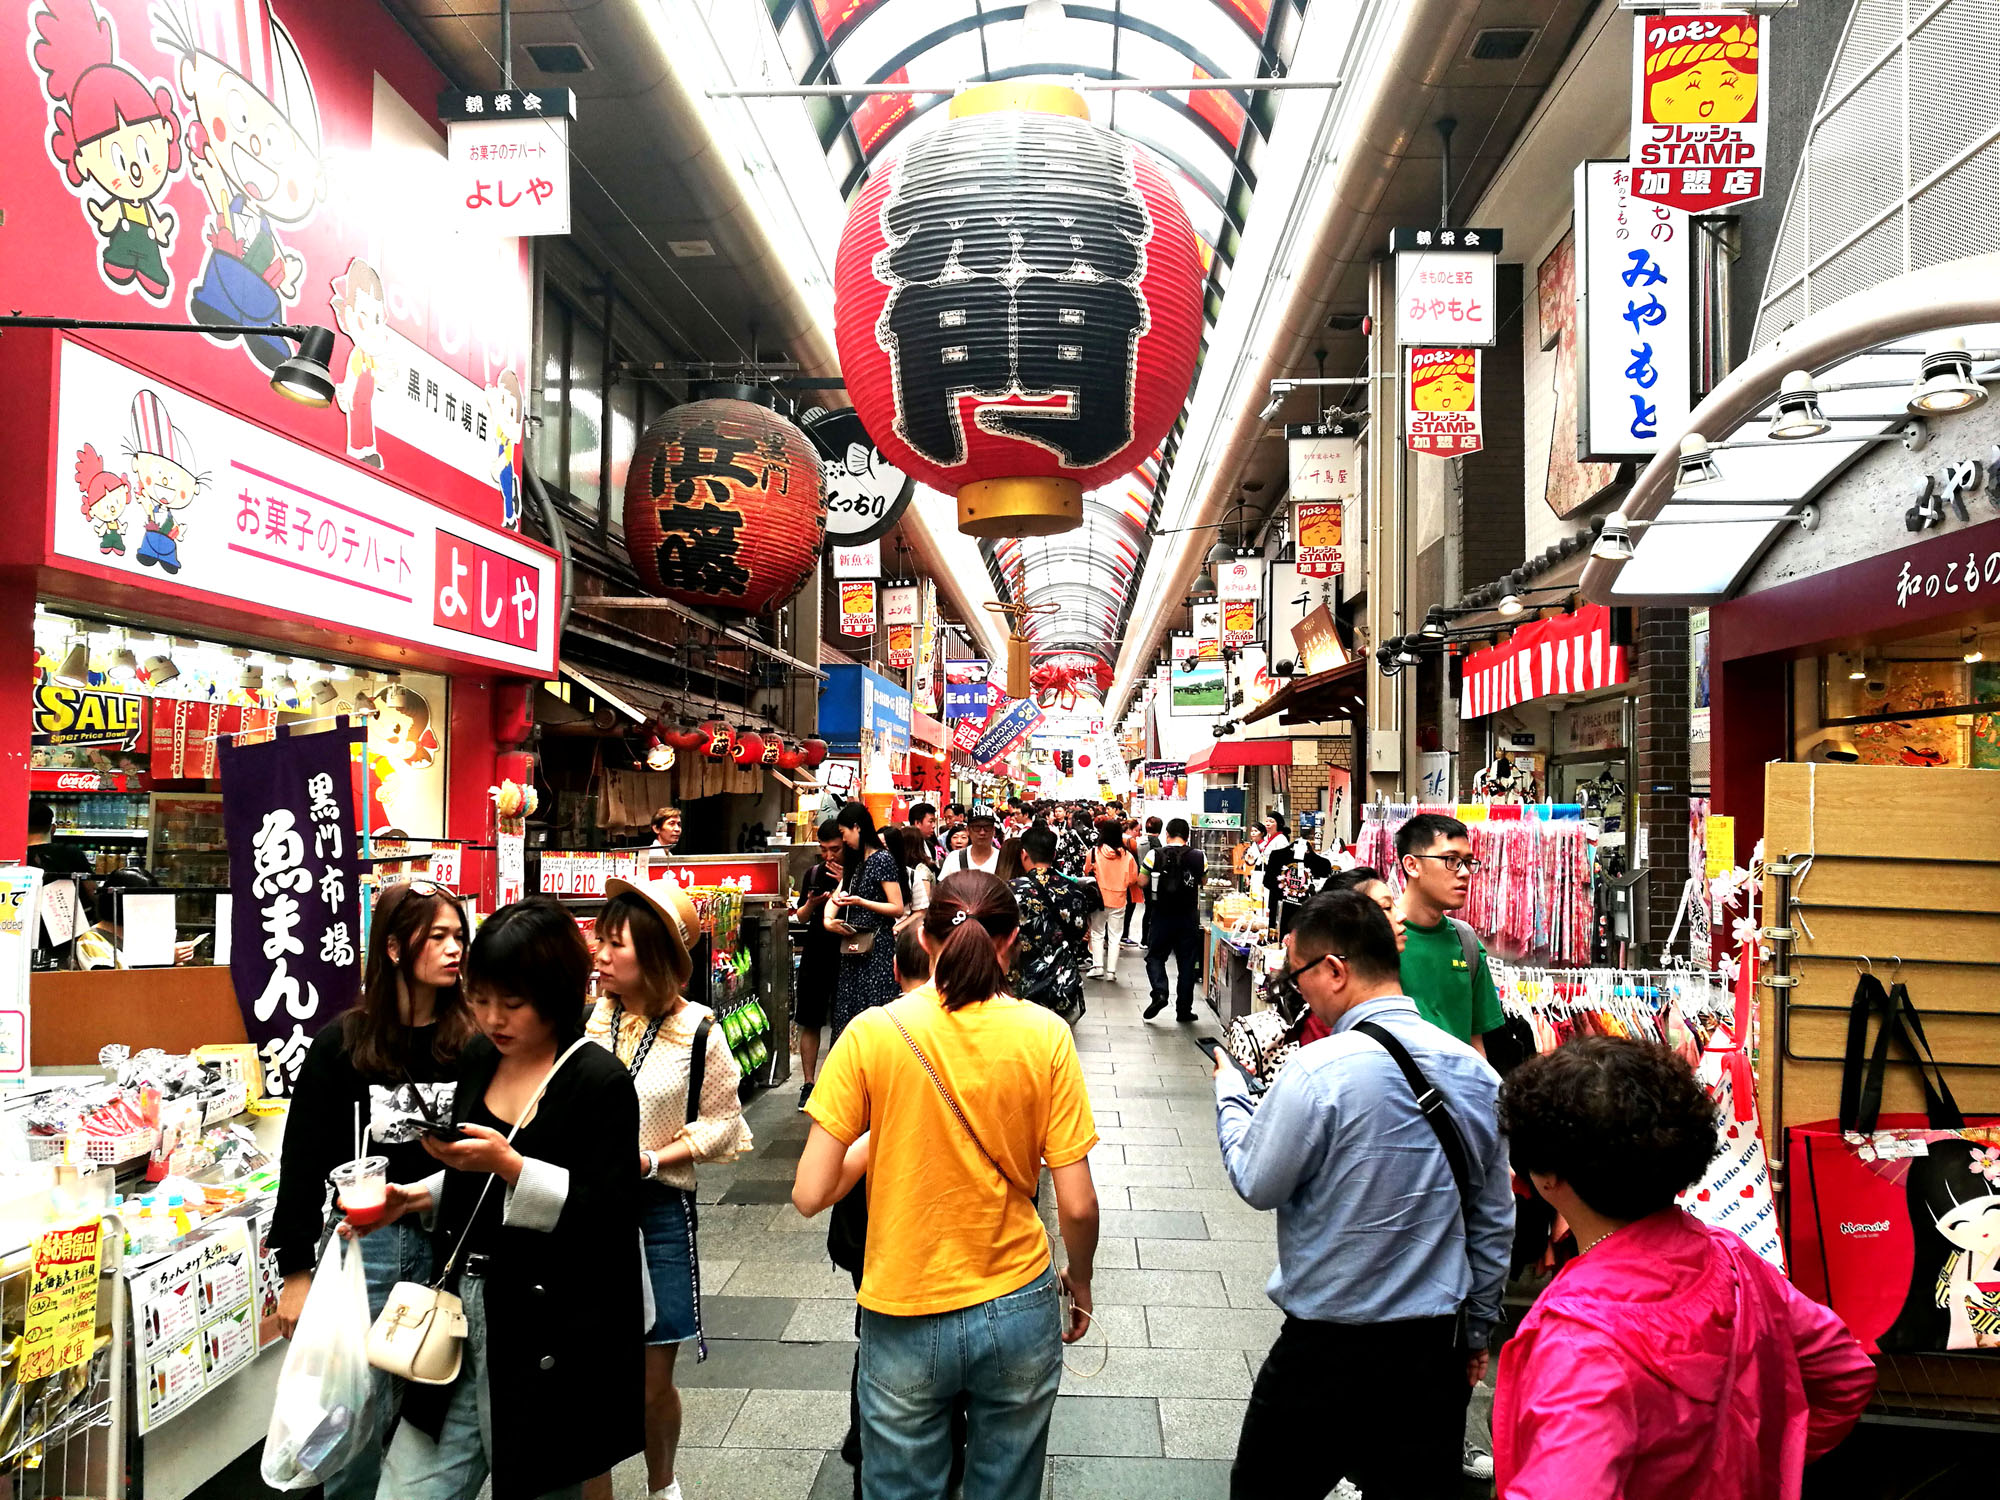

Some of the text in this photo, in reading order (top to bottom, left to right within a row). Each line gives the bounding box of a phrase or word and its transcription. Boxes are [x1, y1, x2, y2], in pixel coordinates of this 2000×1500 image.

[1649, 21, 1722, 49] クロモン
[1652, 125, 1743, 142] フレッシュ
[1641, 143, 1755, 164] STAMP
[1639, 170, 1754, 194] 加盟店
[466, 177, 553, 209] よしや
[1613, 170, 1630, 240] 和のこもの
[1419, 271, 1473, 284] きものと宝石
[1409, 297, 1482, 321] みやもと
[1622, 248, 1668, 439] みやもと
[1413, 350, 1455, 367] クロモン
[407, 368, 488, 441] 黒門市場店
[1412, 421, 1476, 433] STAMP
[1417, 411, 1468, 422] フレッシュ
[1412, 435, 1477, 449] 加盟店
[1300, 506, 1327, 518] クロモン
[1299, 552, 1342, 562] STAMP
[1300, 562, 1343, 573] 加盟店
[440, 546, 537, 639] よしや
[40, 685, 140, 731] SALE
[947, 692, 988, 704] Eat in
[51, 733, 78, 744] Super
[80, 732, 104, 741] Price
[174, 699, 187, 775] Welcome
[975, 719, 1014, 757] EXCHANGE
[989, 721, 1026, 758] CURRENCY
[308, 772, 355, 967] 黒門市場
[436, 863, 453, 882] 88
[543, 872, 564, 892] 210
[574, 873, 595, 892] 210
[0, 920, 23, 930] dded
[1712, 1139, 1759, 1191] Hello Kitty
[1754, 1162, 1768, 1187] Hell
[1738, 1199, 1774, 1239] ello Kitt
[1756, 1236, 1778, 1257] itty
